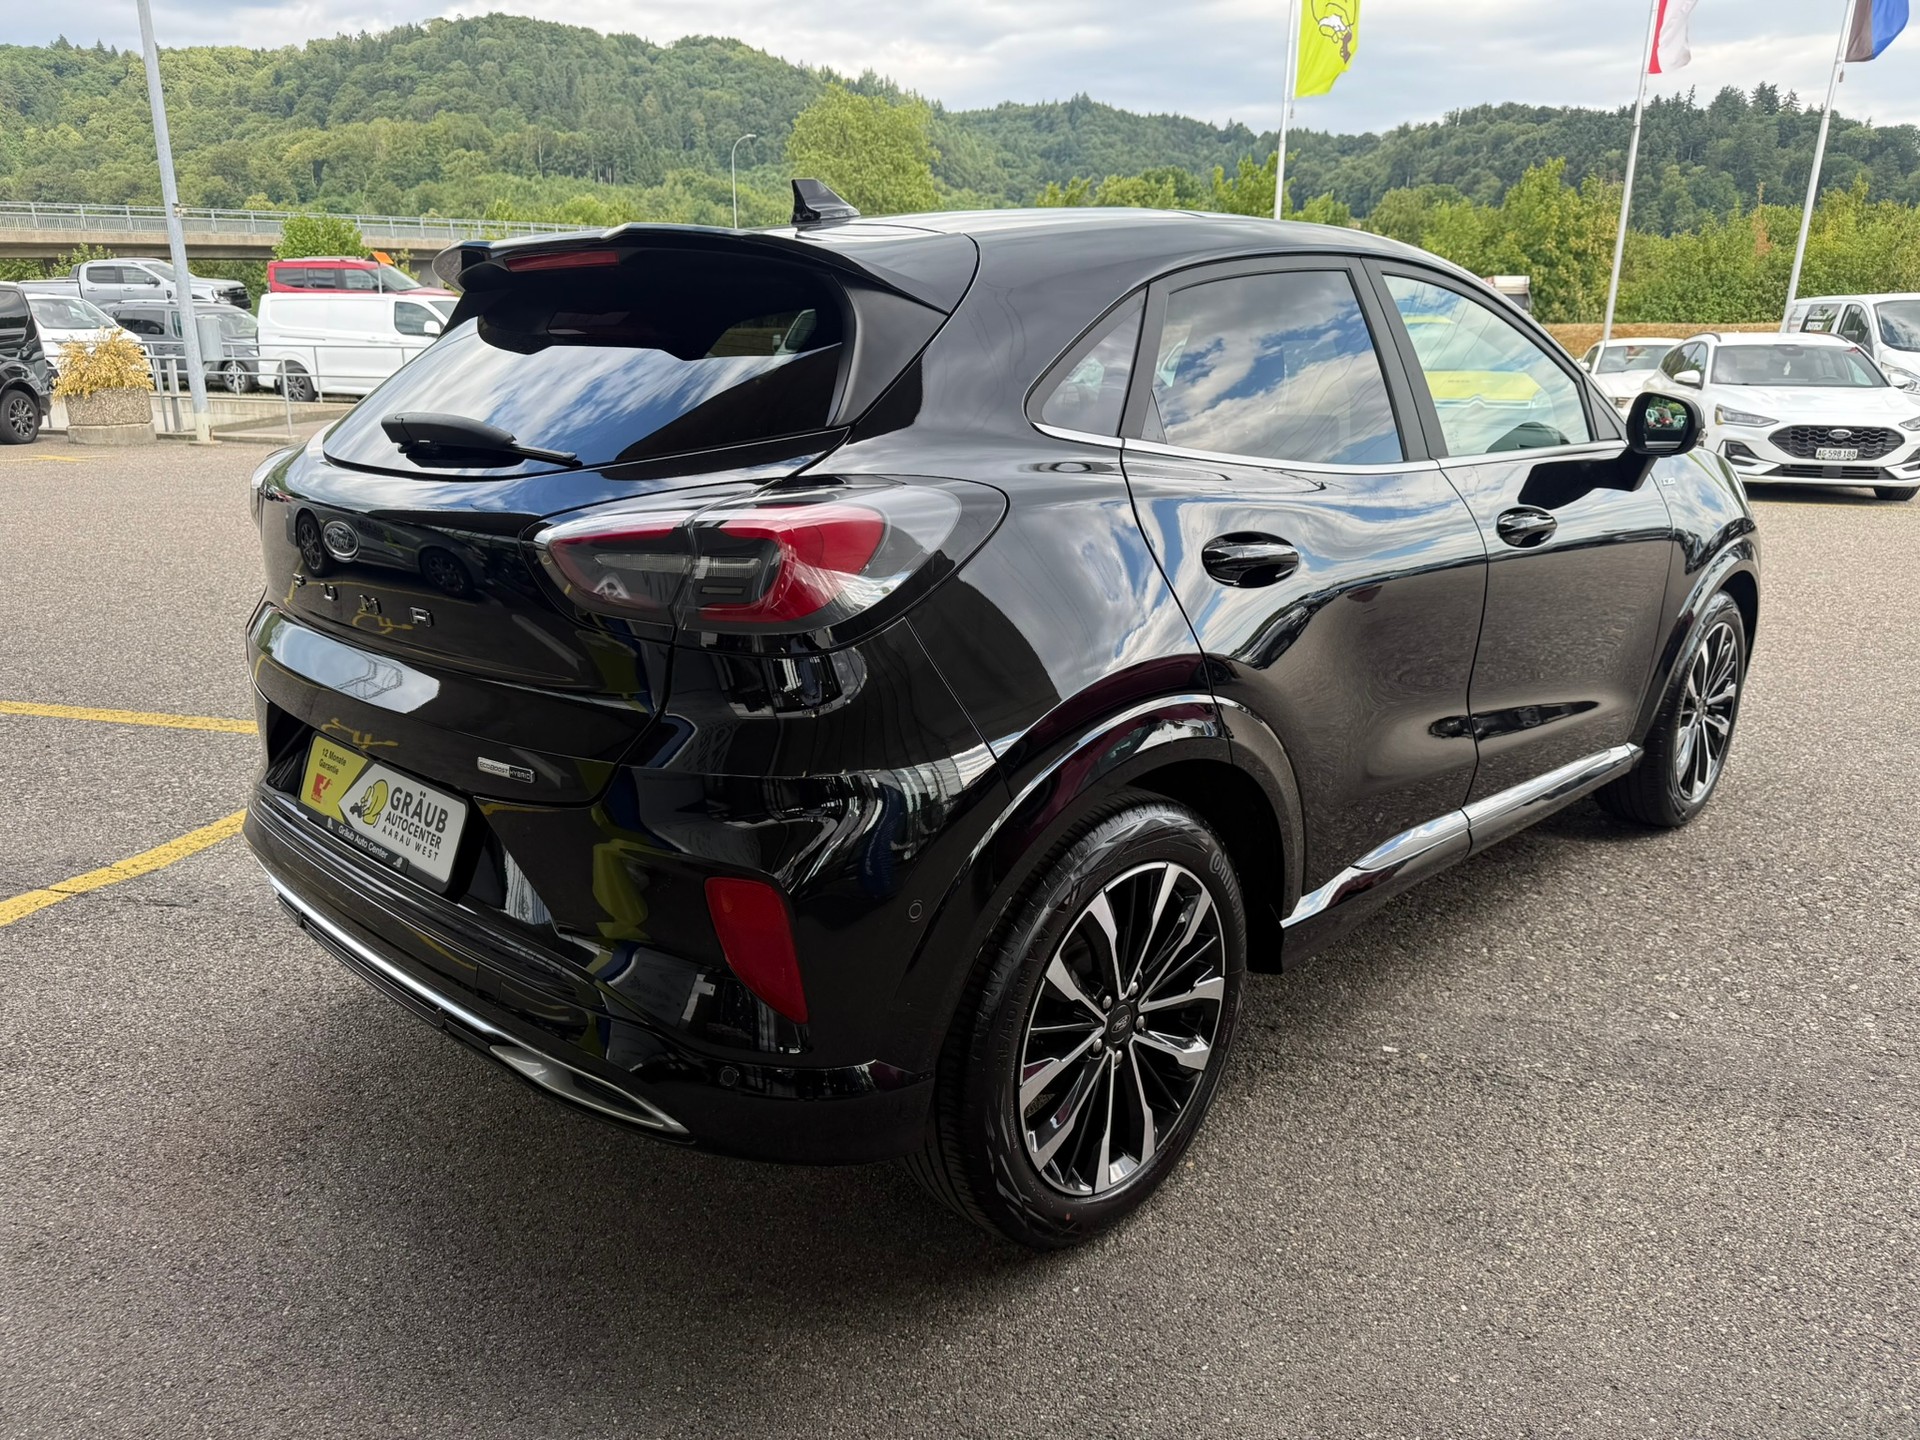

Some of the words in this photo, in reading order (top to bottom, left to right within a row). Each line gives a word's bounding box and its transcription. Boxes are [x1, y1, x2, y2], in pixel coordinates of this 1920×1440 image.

[326, 527, 350, 549] Ford
[319, 758, 339, 775] Garantie
[322, 747, 329, 758] 12
[329, 750, 347, 766] Monate
[510, 769, 531, 780] HYBRID
[390, 786, 449, 834] GRÄUB
[338, 825, 355, 841] Gräub
[354, 835, 368, 848] Auto
[368, 842, 389, 859] Center
[381, 825, 411, 847] AARAU
[414, 841, 439, 861] WEST
[385, 810, 442, 850] AUTOCENTER
